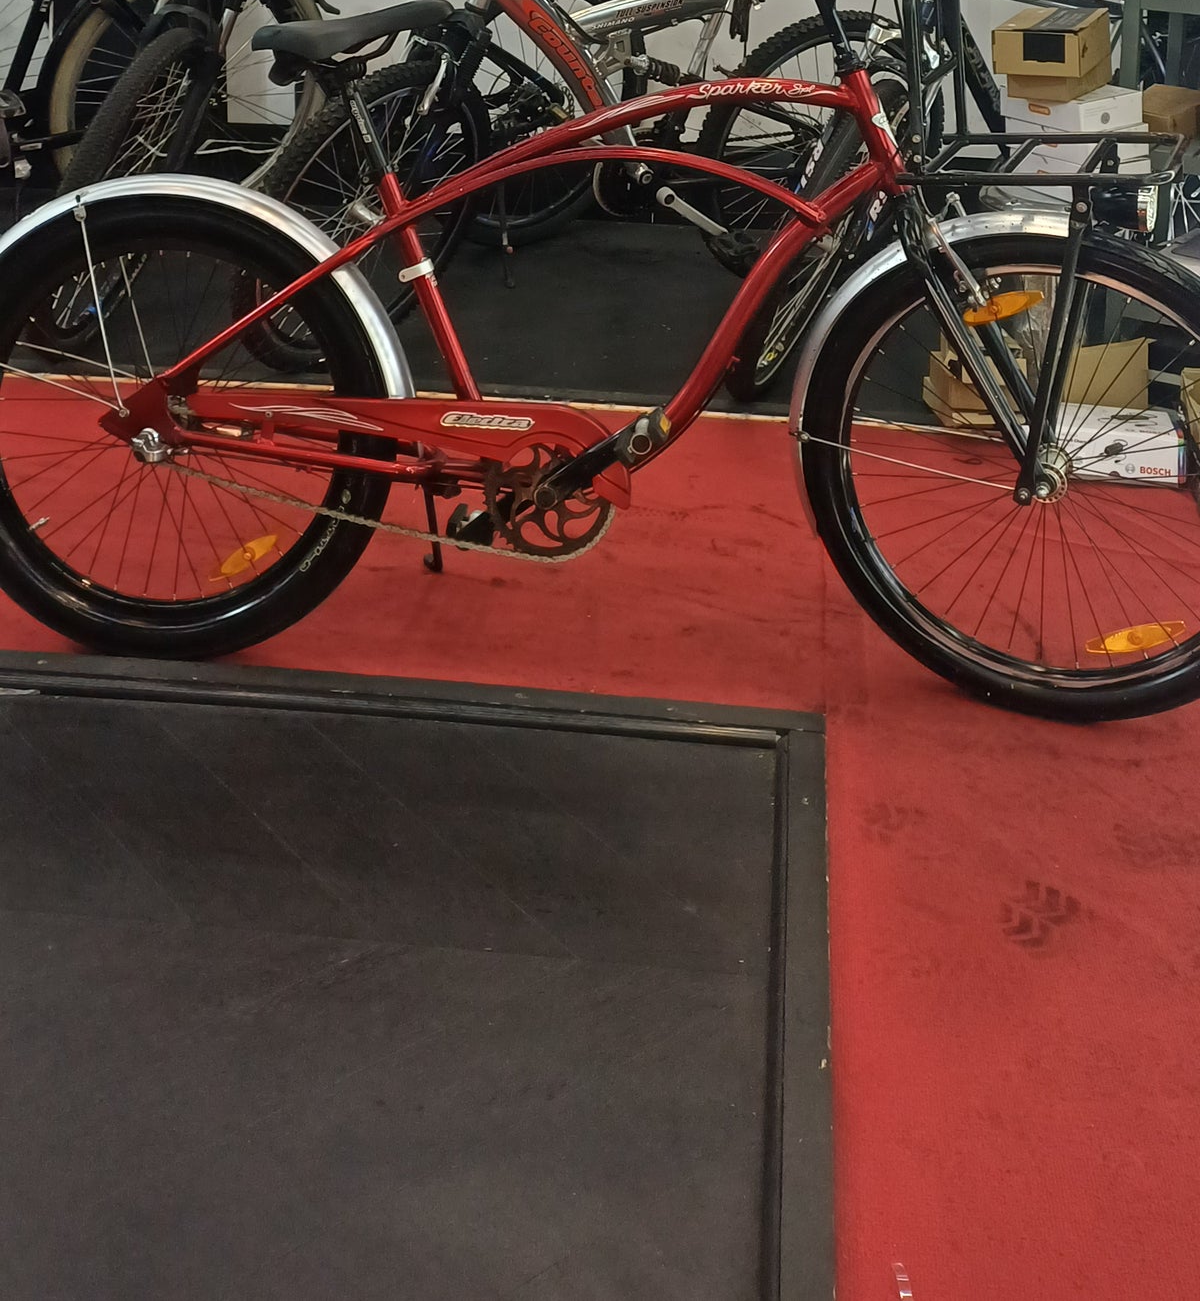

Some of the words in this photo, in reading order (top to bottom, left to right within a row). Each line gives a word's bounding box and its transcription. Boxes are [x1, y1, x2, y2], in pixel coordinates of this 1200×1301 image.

[592, 17, 635, 29] SHIMANO
[690, 81, 786, 99] Sparker
[1139, 466, 1171, 476] BOSCH
